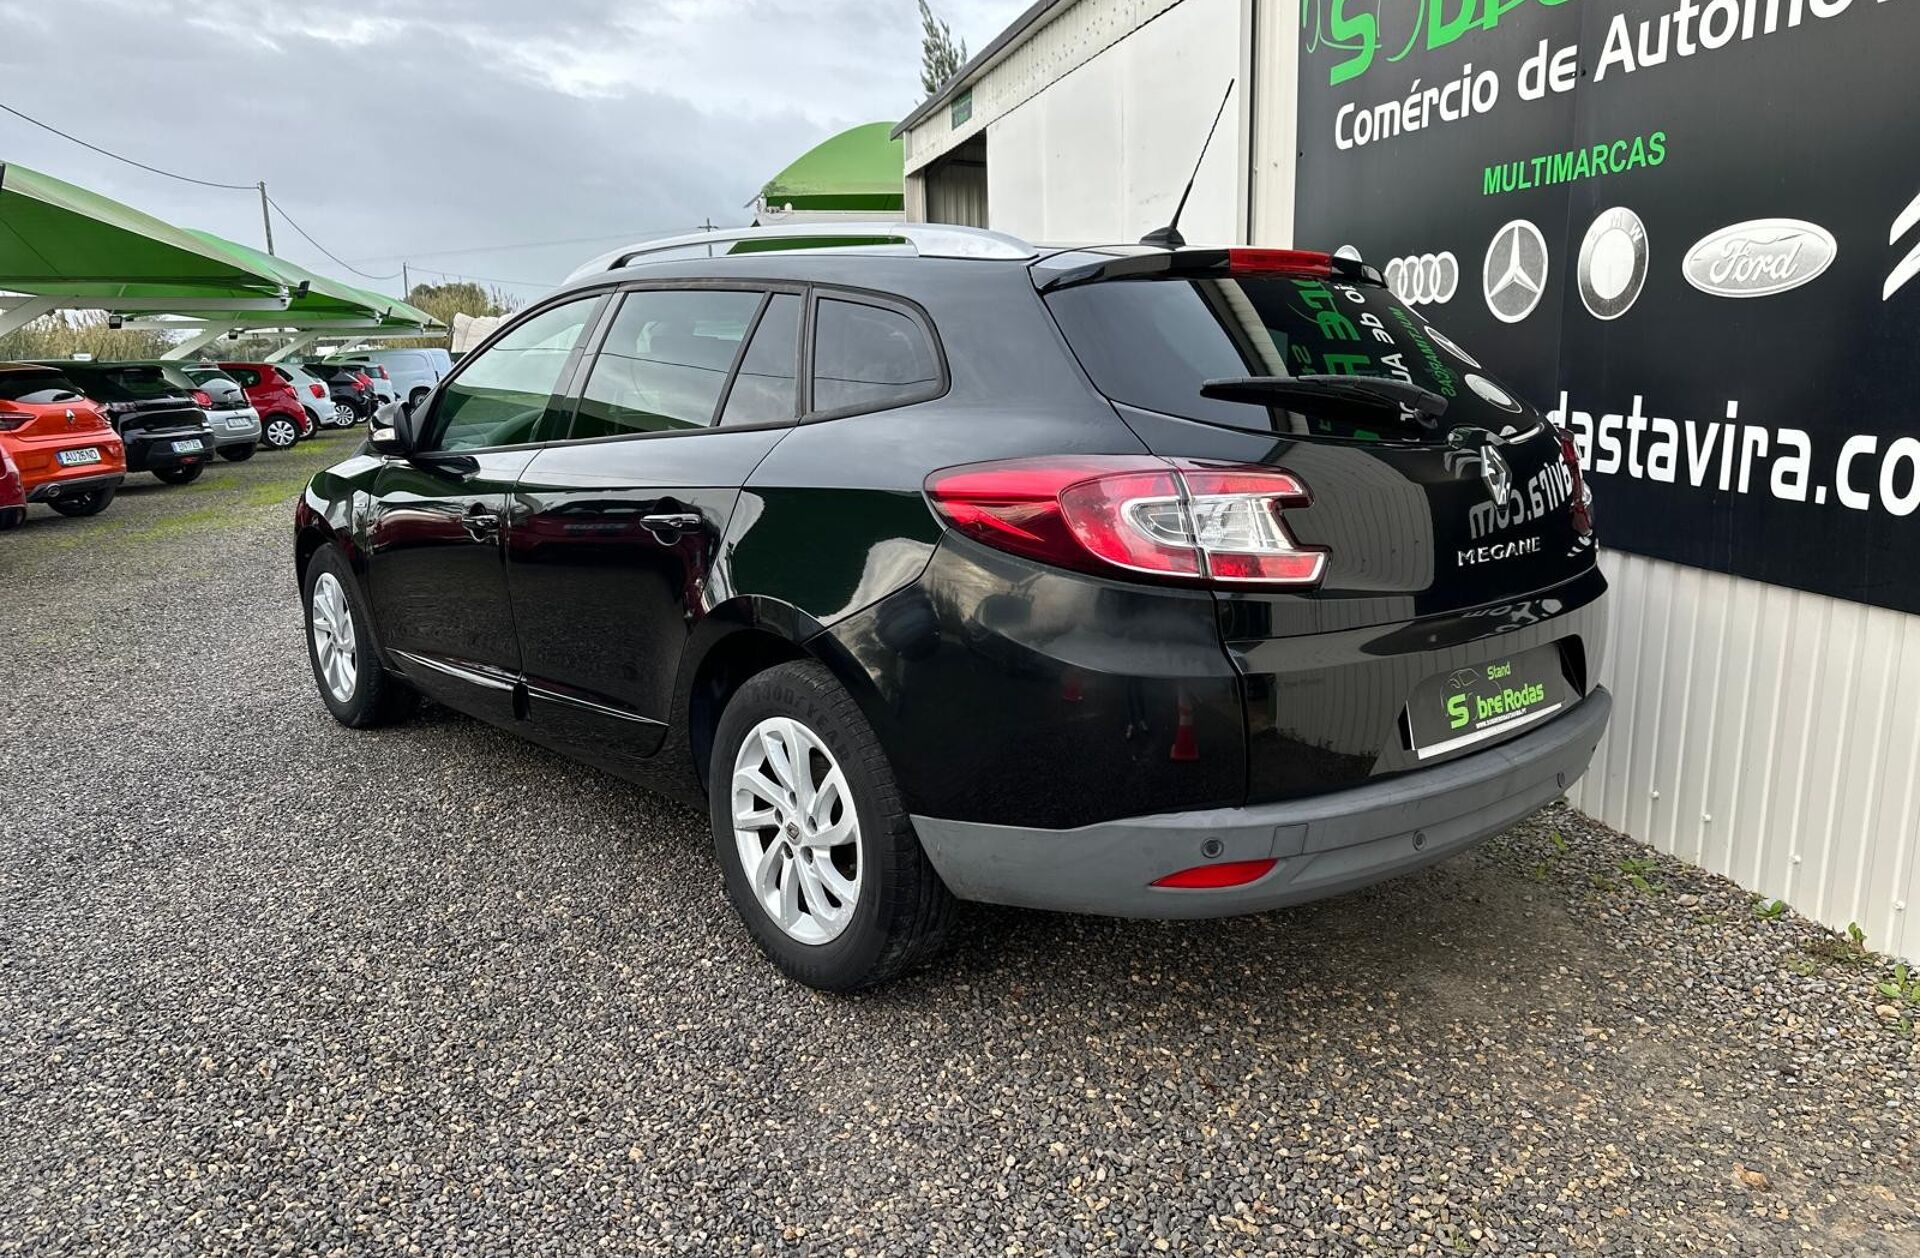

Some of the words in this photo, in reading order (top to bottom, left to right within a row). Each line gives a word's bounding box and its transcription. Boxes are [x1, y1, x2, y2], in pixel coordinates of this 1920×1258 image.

[1335, 62, 1499, 150] Comércio
[1517, 38, 1578, 101] de
[1482, 131, 1667, 196] MULTIMARCAS
[1709, 238, 1804, 284] Ford
[1457, 536, 1541, 567] MEGANE
[1487, 661, 1512, 680] Stand
